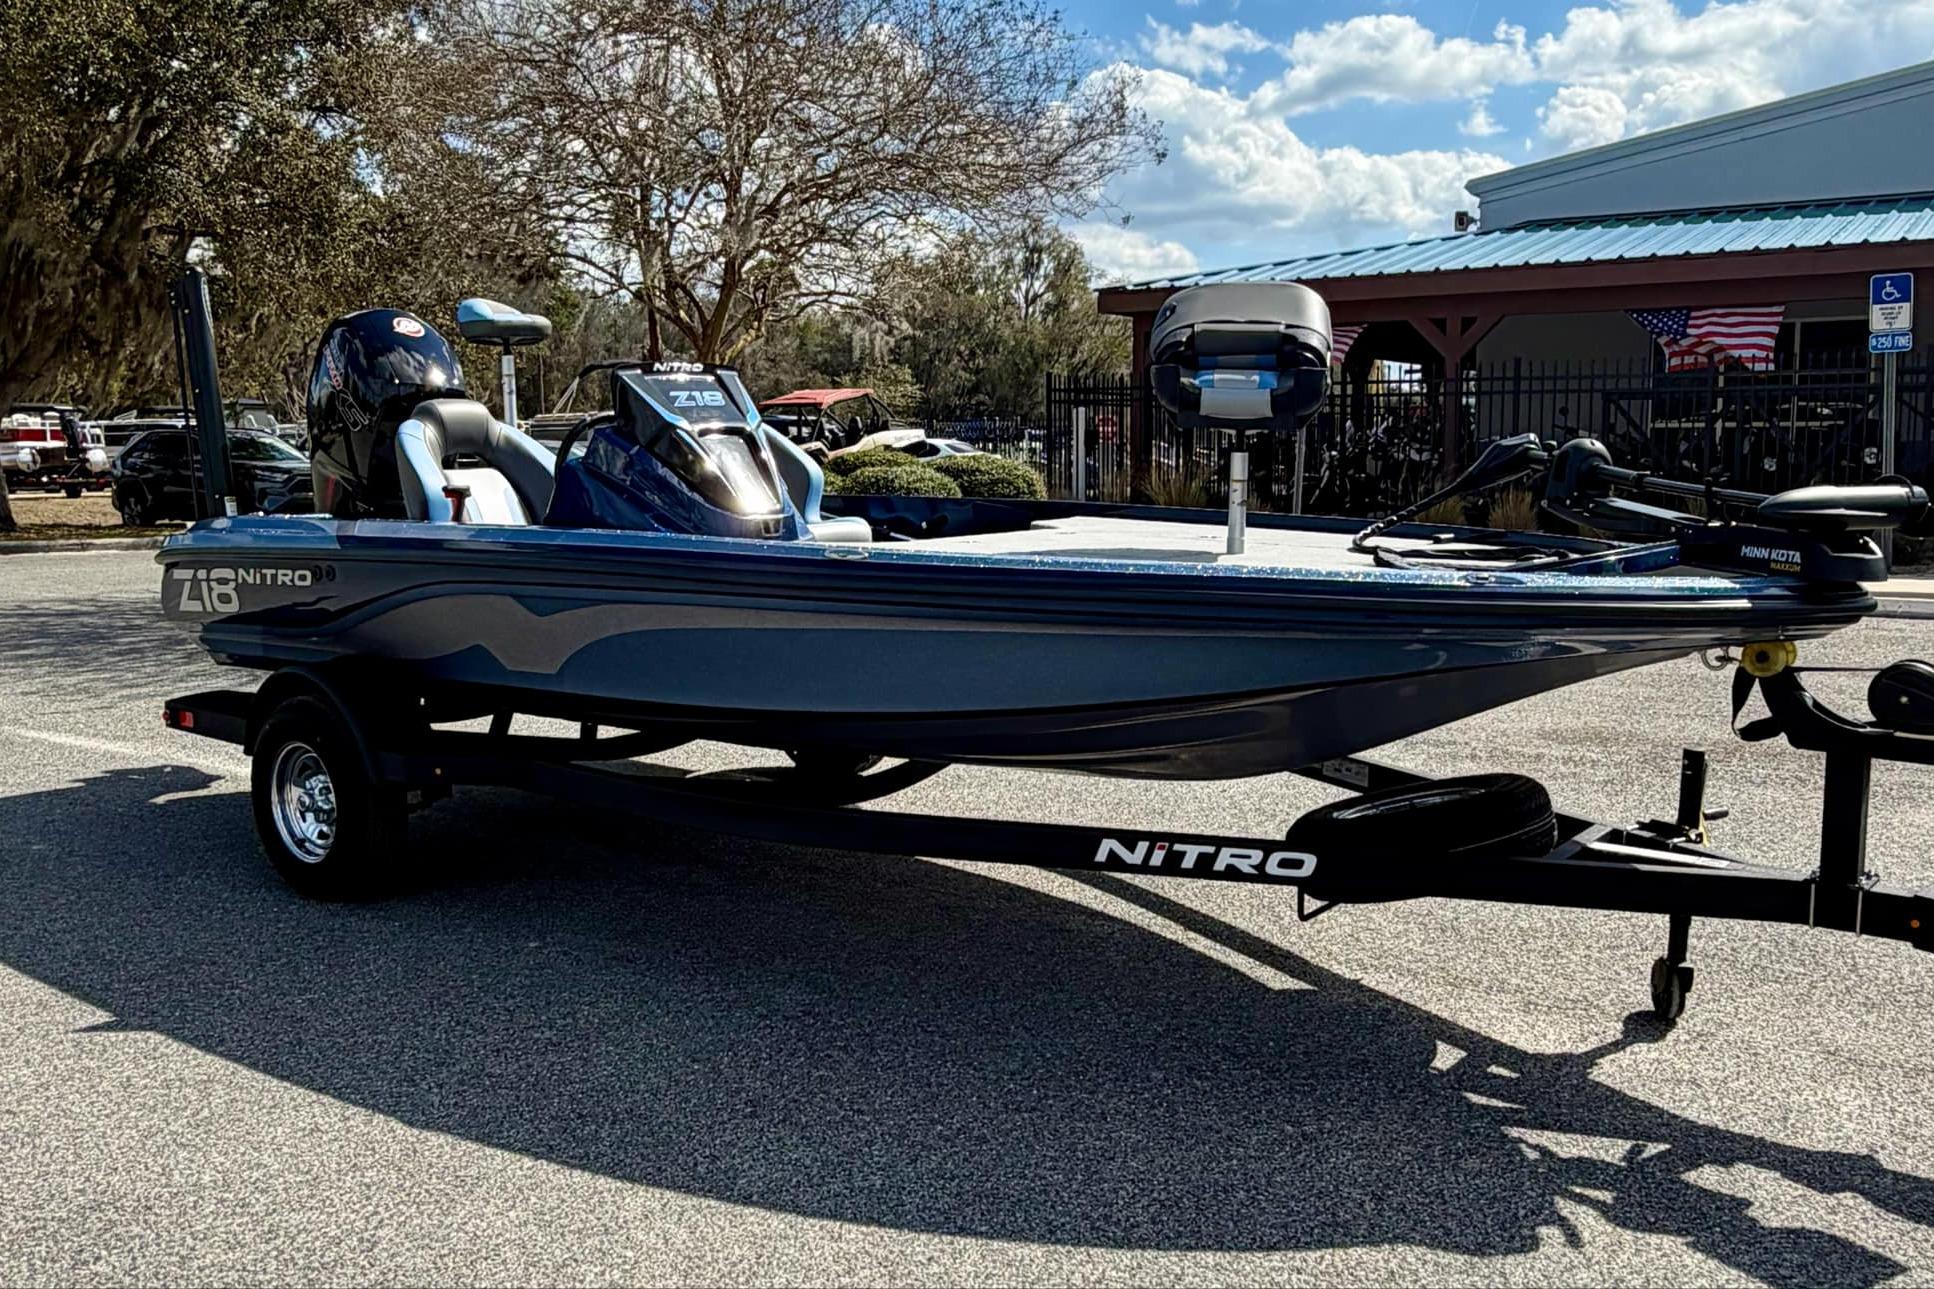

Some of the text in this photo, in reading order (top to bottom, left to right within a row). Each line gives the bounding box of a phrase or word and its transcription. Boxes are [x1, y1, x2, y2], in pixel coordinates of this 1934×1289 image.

[669, 391, 726, 407] Z18
[1741, 545, 1801, 564] MINN KOTA
[172, 568, 240, 613] Z18
